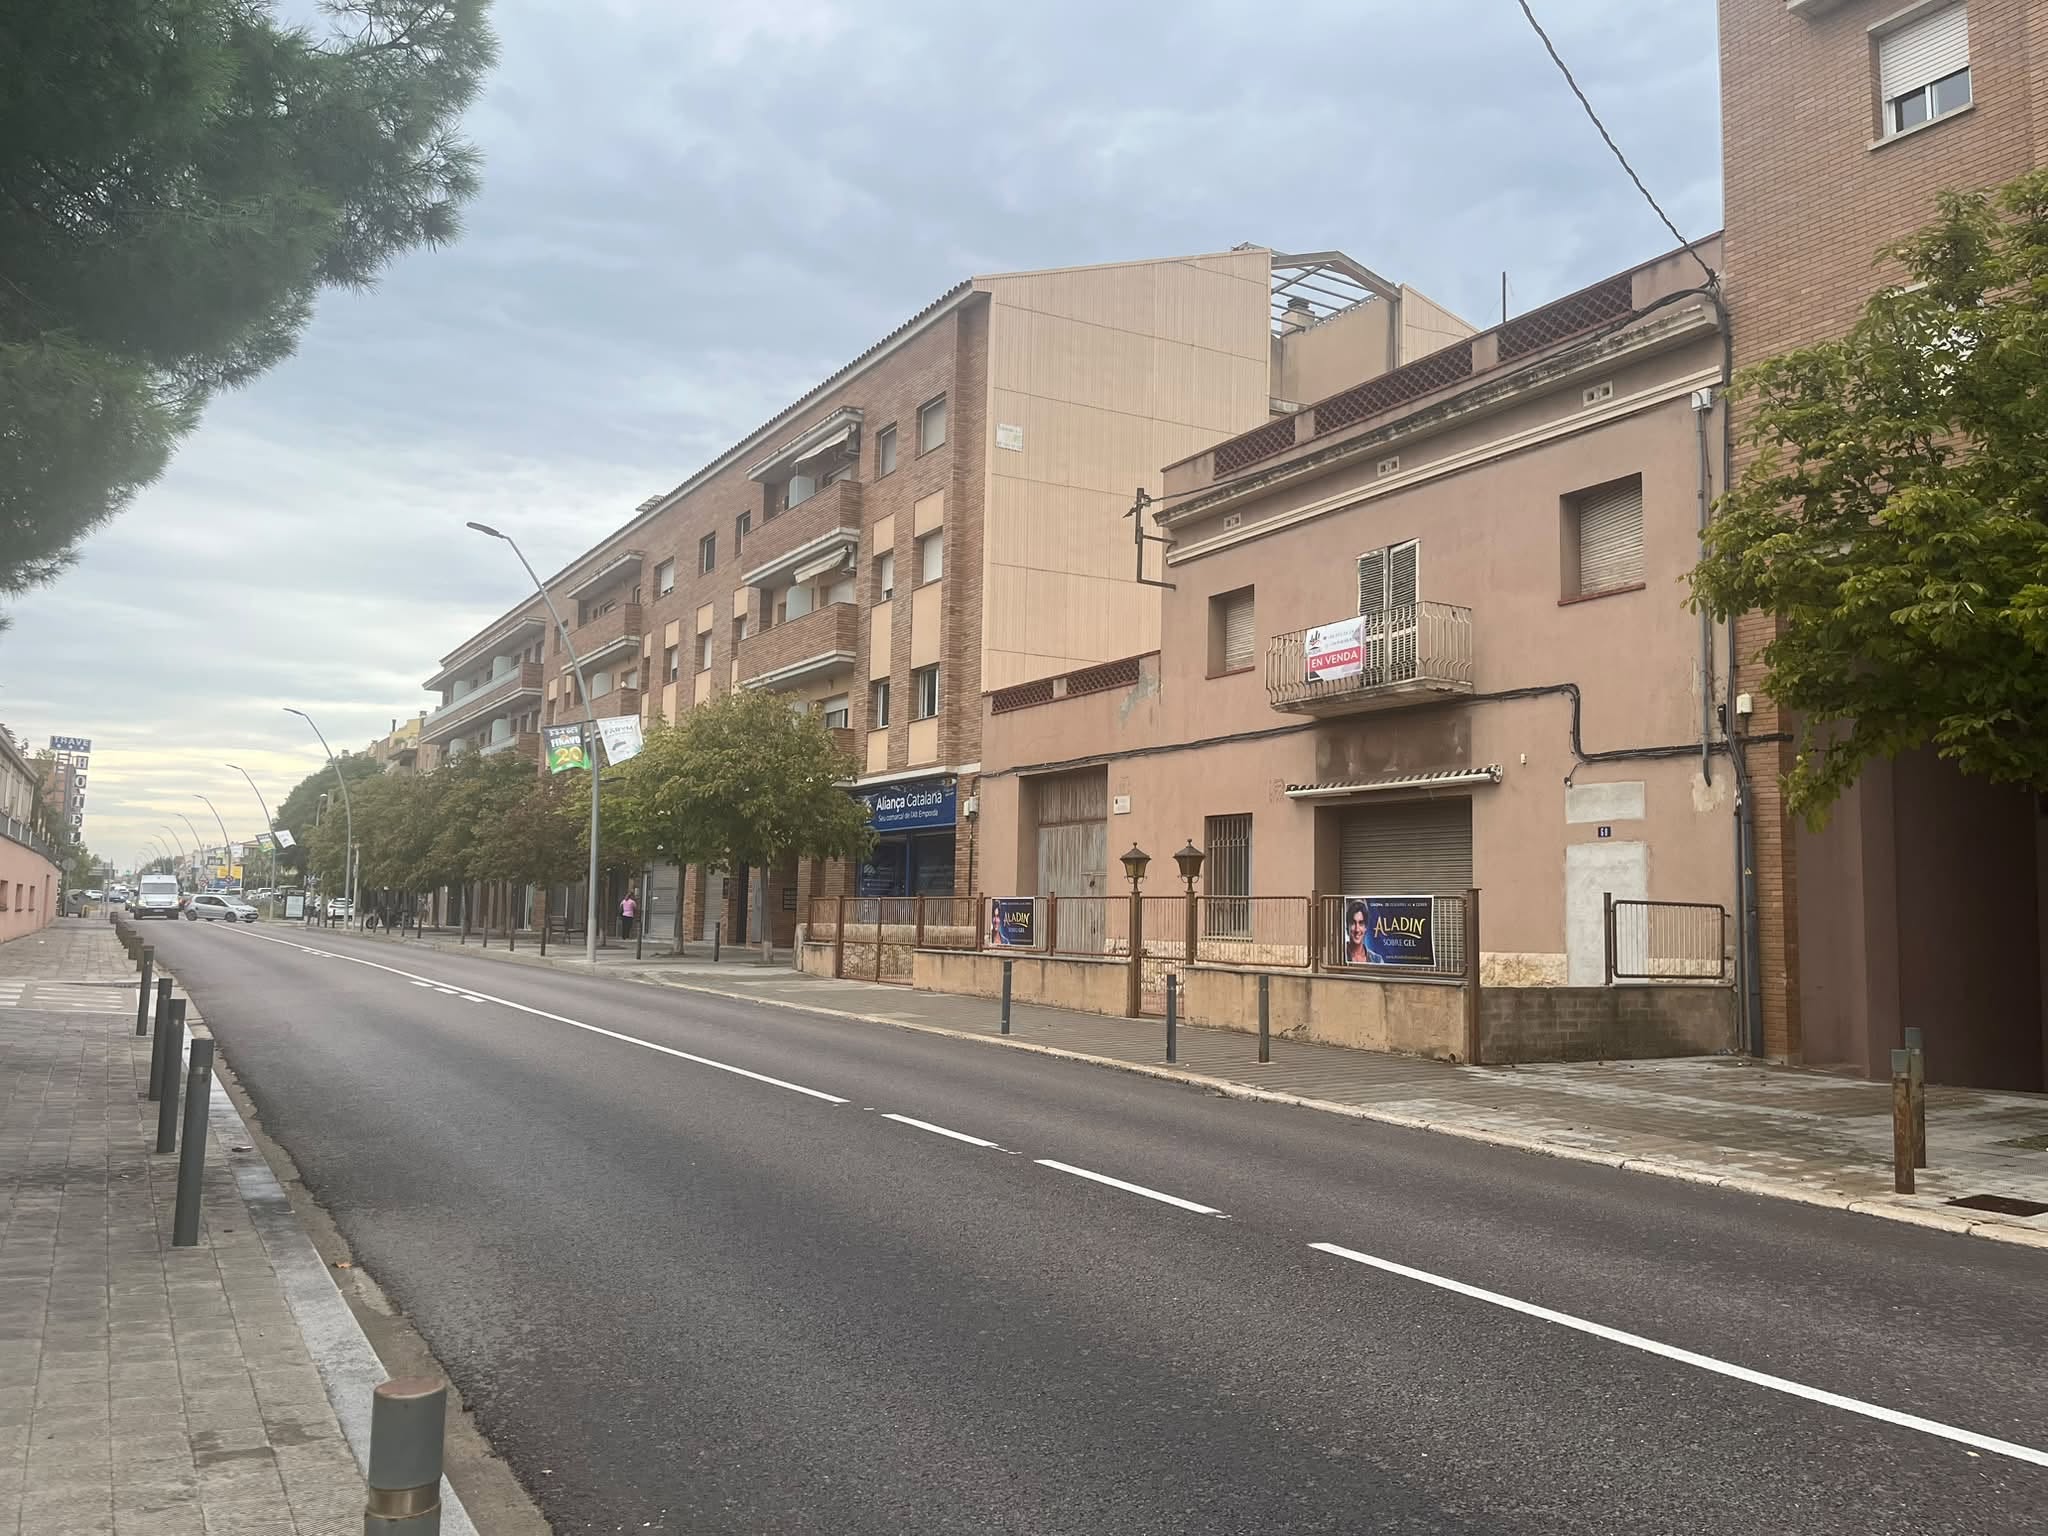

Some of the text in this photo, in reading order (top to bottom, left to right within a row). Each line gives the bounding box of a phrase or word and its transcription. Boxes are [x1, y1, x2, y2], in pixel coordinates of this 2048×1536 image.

[1311, 658, 1323, 668] EN
[1326, 650, 1358, 665] VENDA
[54, 736, 89, 747] TRAVE
[69, 757, 88, 845] HOTEL
[876, 795, 906, 812] Aliança
[906, 790, 943, 807] Catalana
[1003, 911, 1030, 927] ALADIN
[1373, 916, 1426, 937] ALADIN
[1383, 938, 1416, 947] SOBRE GEL
